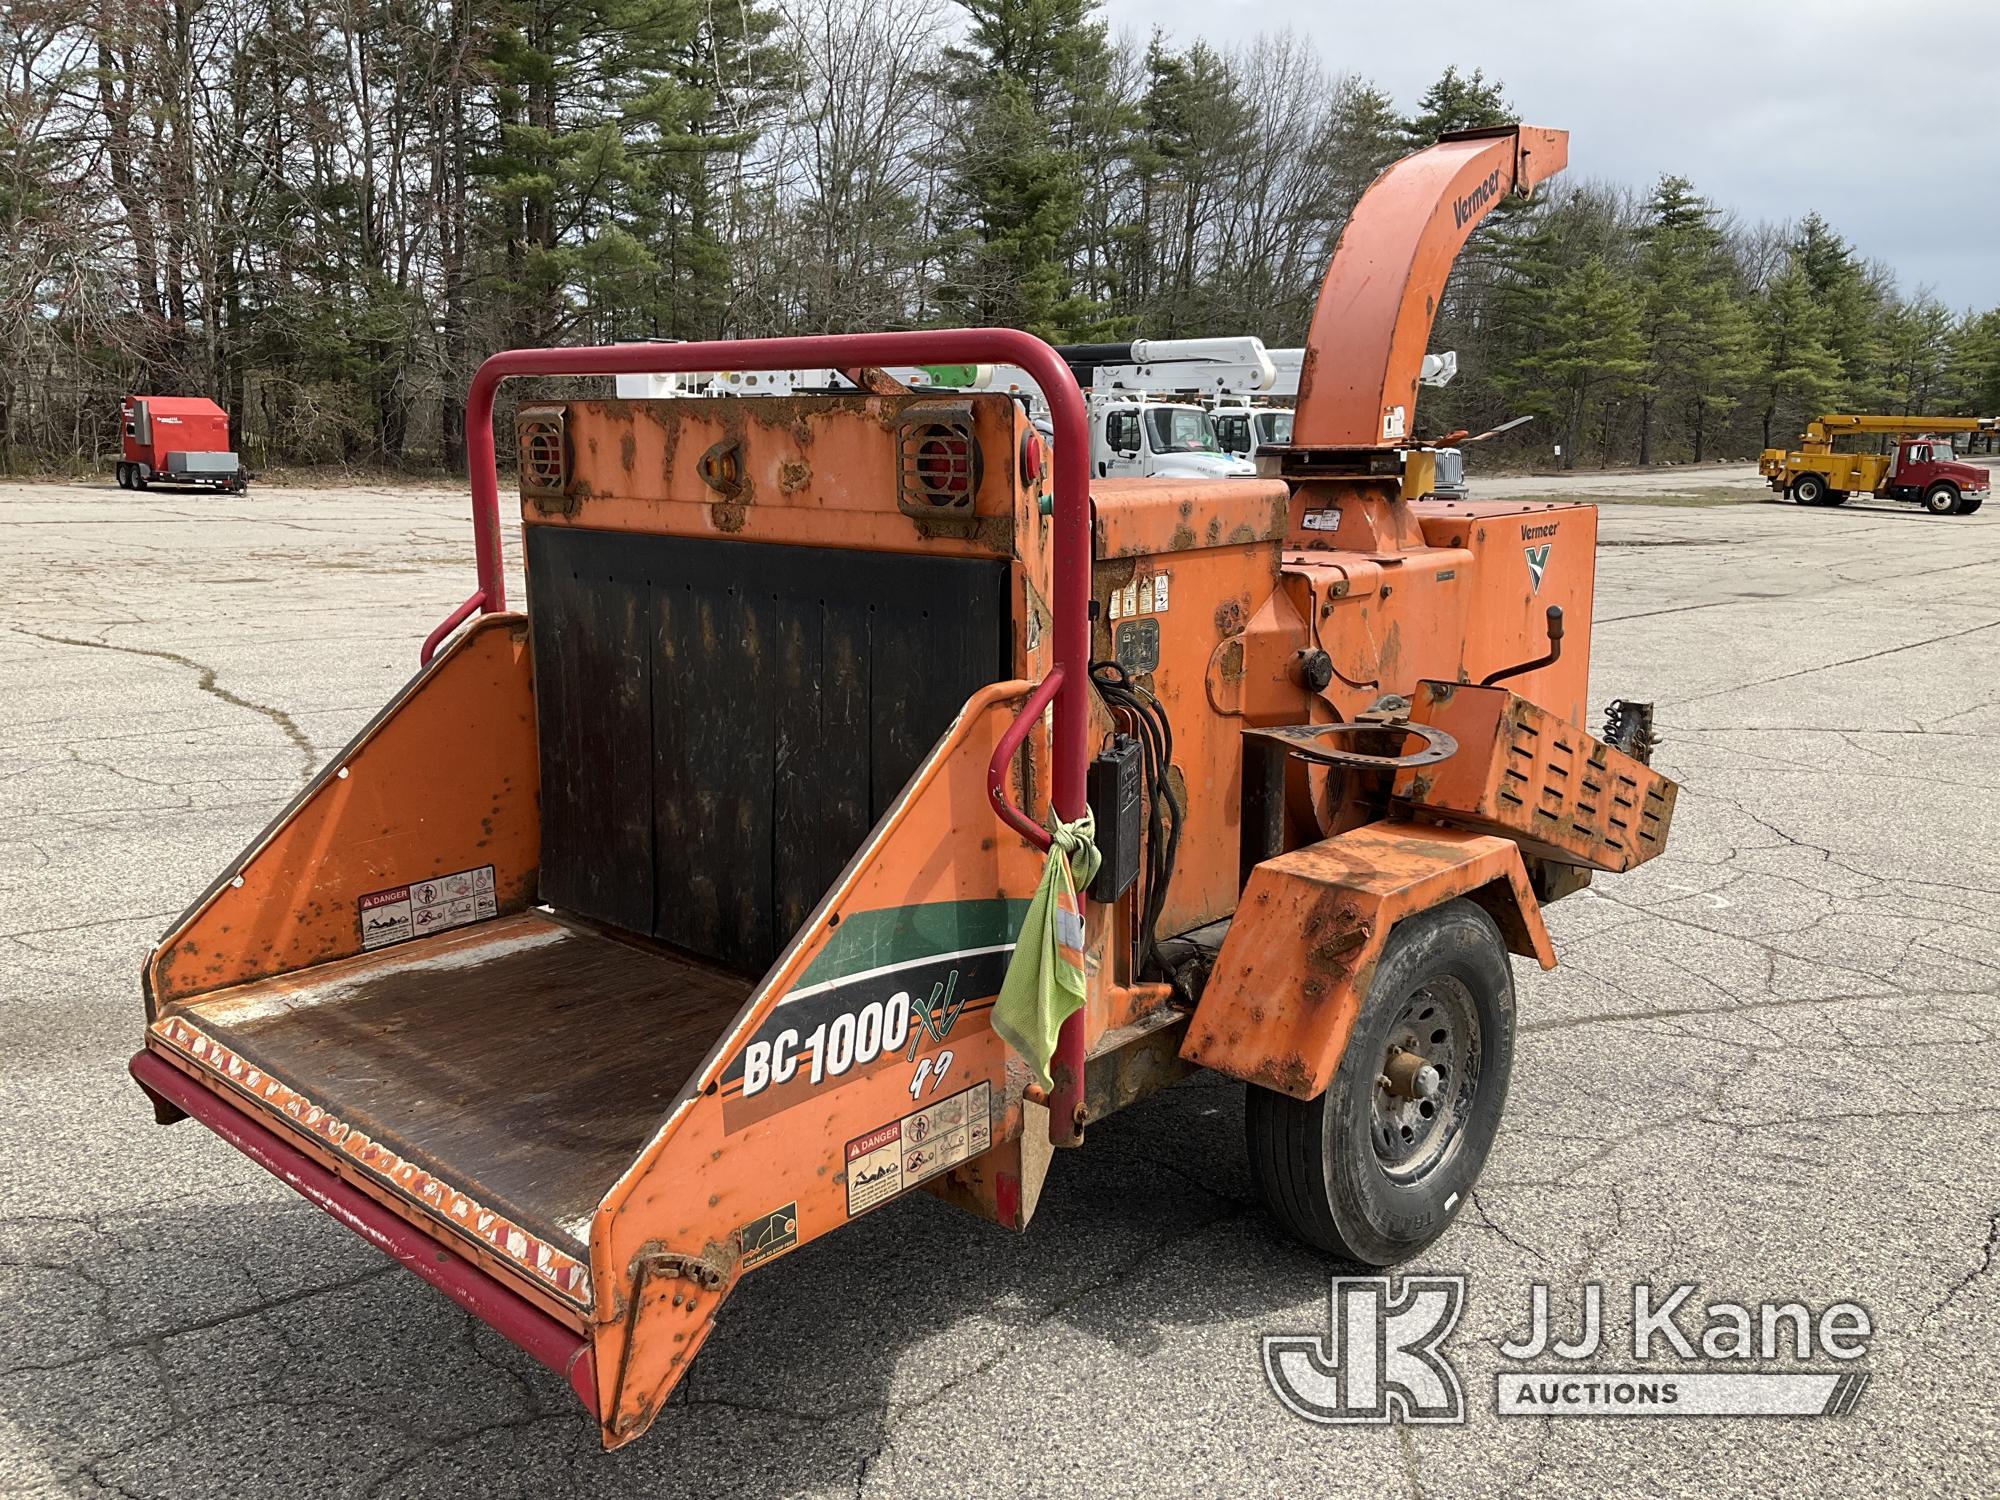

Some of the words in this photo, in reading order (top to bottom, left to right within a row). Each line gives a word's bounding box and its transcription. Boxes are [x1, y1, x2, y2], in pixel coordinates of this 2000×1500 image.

[1453, 168, 1499, 230] Vermeer
[1521, 524, 1558, 541] Vermeer
[373, 890, 408, 905] DANGER
[861, 1126, 898, 1151] DANGER
